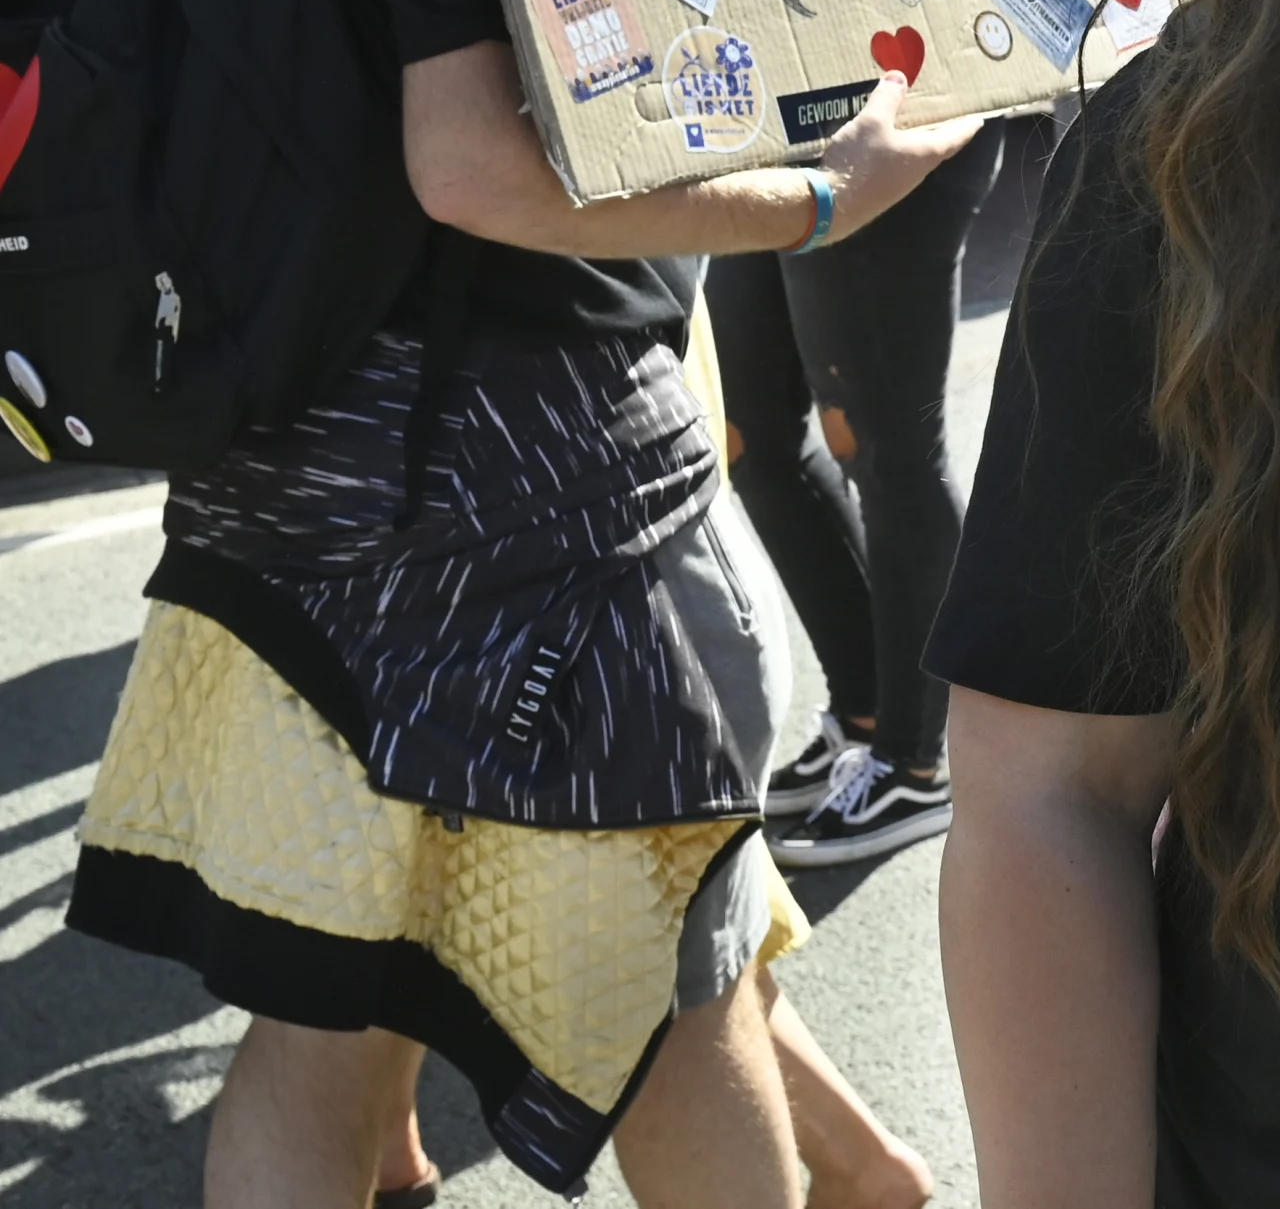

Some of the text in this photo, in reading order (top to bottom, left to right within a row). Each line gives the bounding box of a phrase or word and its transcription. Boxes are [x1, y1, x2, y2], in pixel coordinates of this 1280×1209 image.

[564, 7, 622, 50] DEMO
[680, 73, 753, 98] LIEFDE
[798, 92, 873, 126] GEWOON NE
